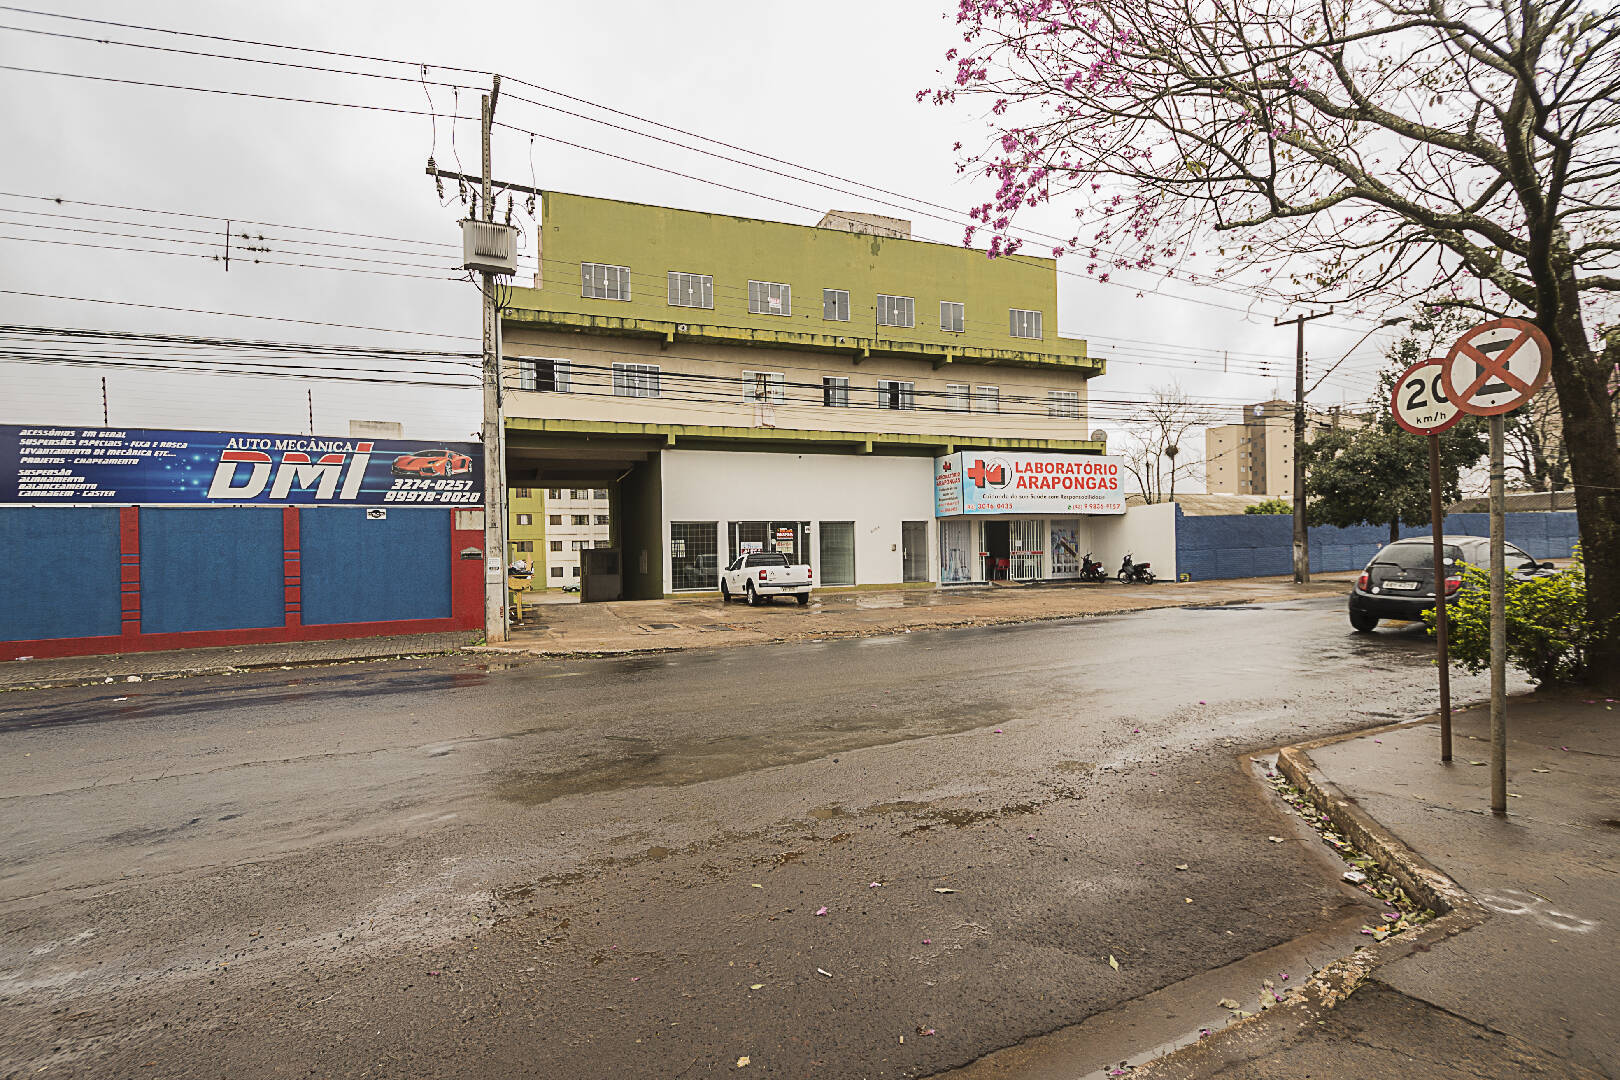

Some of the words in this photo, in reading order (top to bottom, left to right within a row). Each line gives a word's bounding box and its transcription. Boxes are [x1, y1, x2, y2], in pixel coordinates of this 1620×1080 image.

[1417, 411, 1446, 424] km/h
[19, 429, 76, 437] ACESSÓRIOS
[99, 431, 126, 439] GERAL
[19, 438, 77, 446] SUSPENSÕES
[226, 437, 272, 451] AUTO
[274, 438, 354, 453] MECÂNICA
[107, 448, 153, 457] MECÂNICA
[18, 468, 72, 476] SUSPENSÃO
[1015, 460, 1118, 476] LABORATÓRIO
[391, 478, 473, 491] 3274-0257
[1016, 475, 1118, 490] ARAPONGAS
[384, 490, 481, 503] 99978-0020
